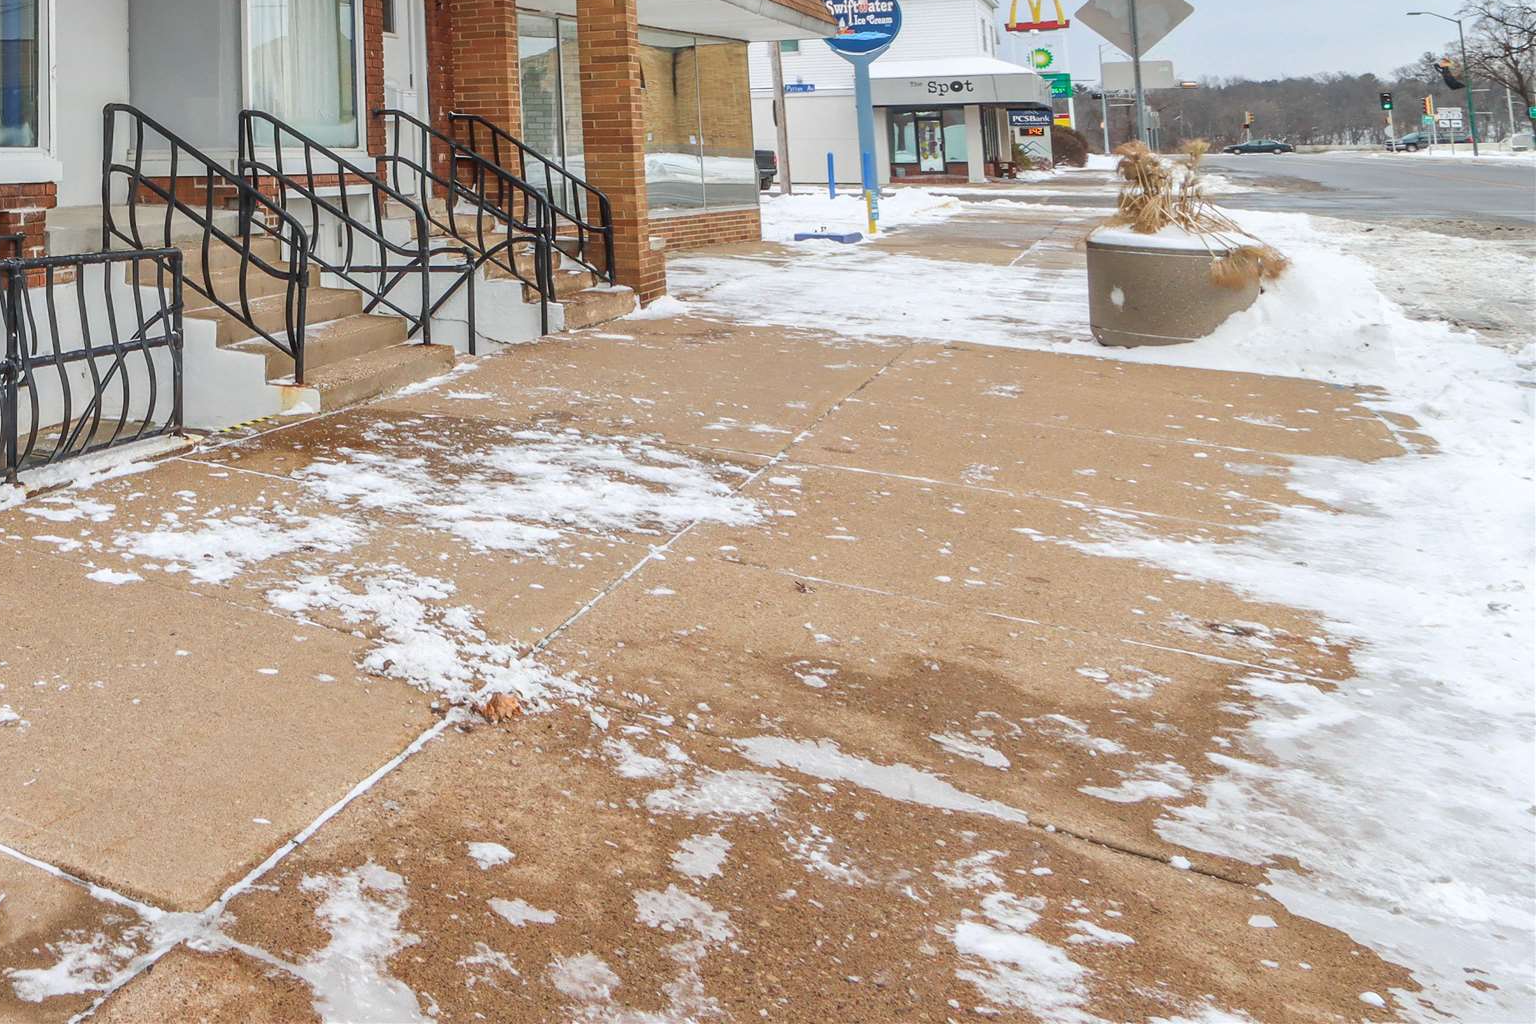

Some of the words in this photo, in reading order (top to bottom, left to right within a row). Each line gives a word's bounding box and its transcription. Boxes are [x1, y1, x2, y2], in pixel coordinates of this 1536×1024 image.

[853, 15, 866, 25] Ice
[867, 15, 893, 25] Cream
[927, 80, 974, 96] Spot
[1012, 114, 1051, 123] PCSBank
